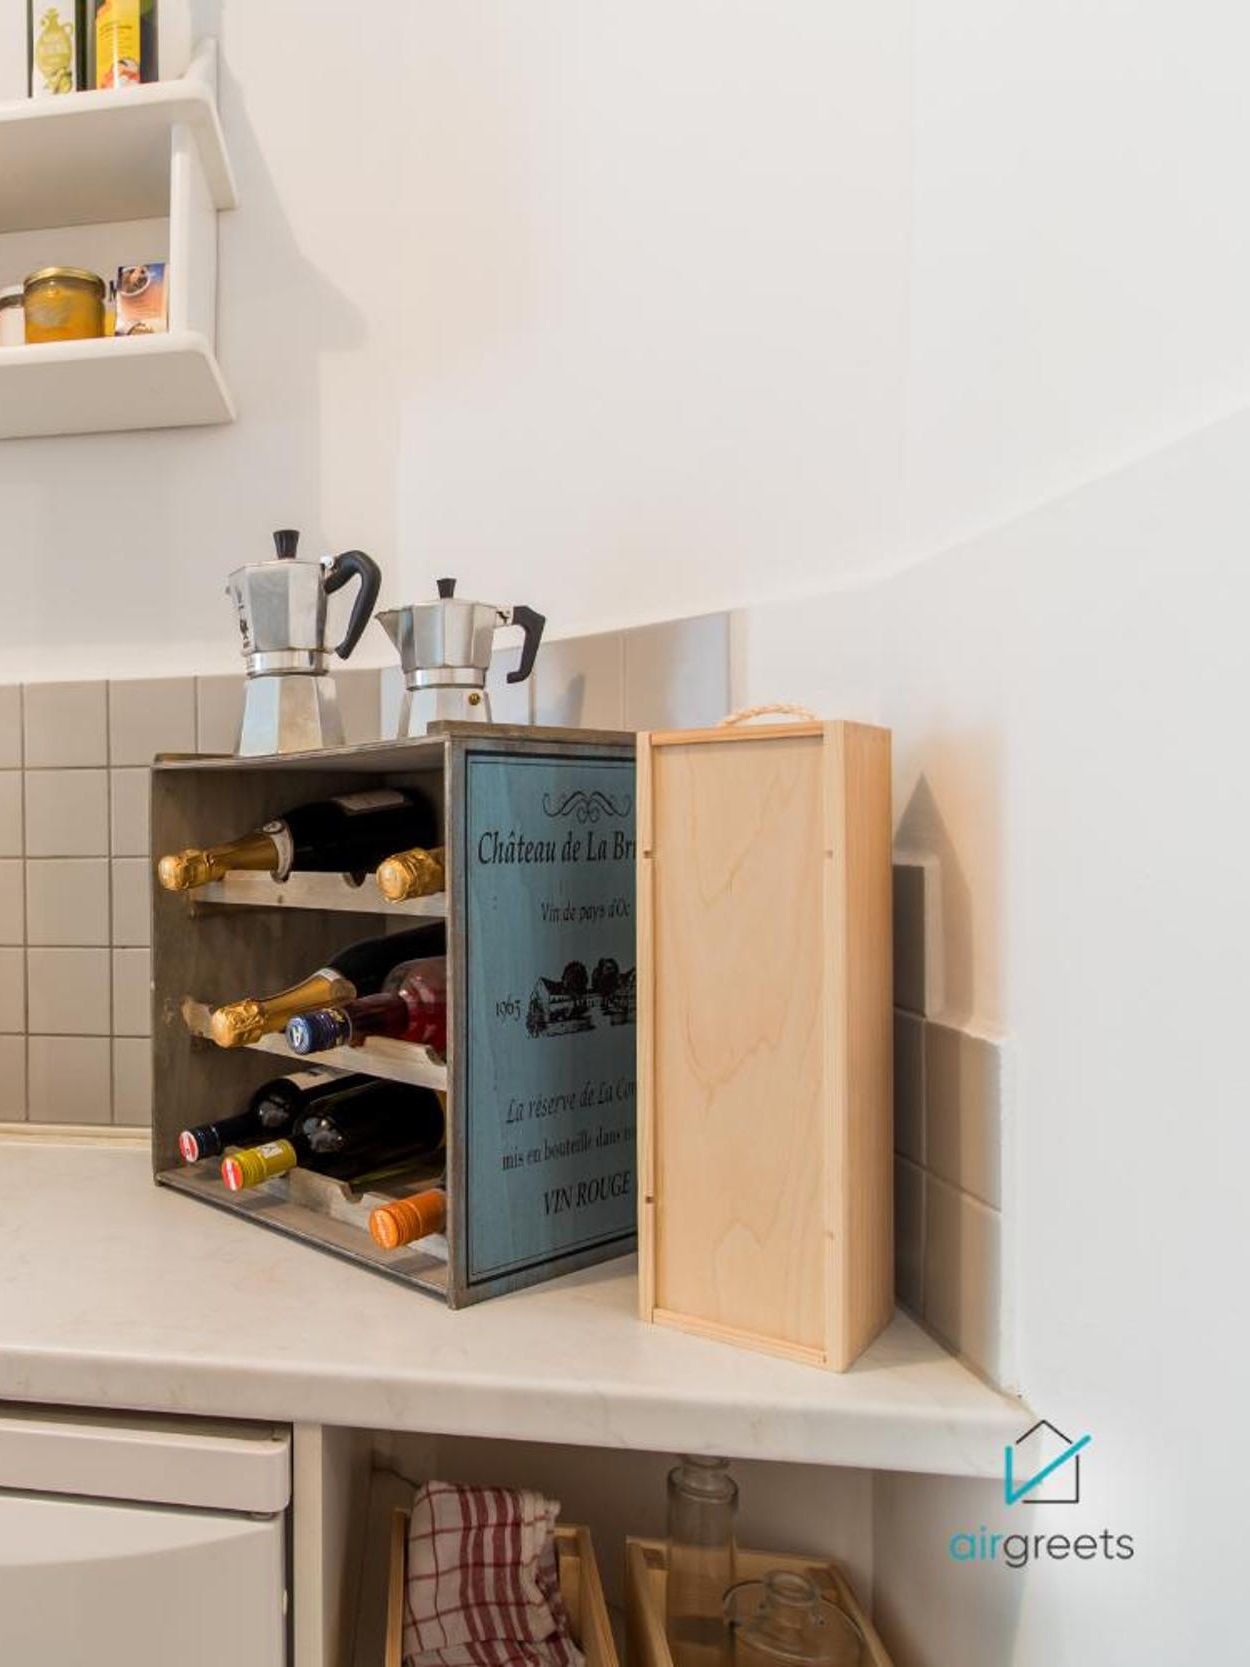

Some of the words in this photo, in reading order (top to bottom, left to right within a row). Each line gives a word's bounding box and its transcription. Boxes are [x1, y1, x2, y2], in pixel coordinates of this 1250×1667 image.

[478, 830, 556, 864] Château
[561, 830, 581, 863] de
[586, 831, 607, 861] La
[541, 901, 559, 922] Vin
[563, 899, 576, 921] de
[579, 903, 605, 923] pays
[506, 1099, 524, 1123] La
[530, 1092, 576, 1119] réserve
[579, 1080, 594, 1107] de
[597, 1081, 612, 1105] La
[502, 1146, 524, 1170] mis
[527, 1148, 542, 1165] en
[544, 1130, 591, 1160] bouteille
[596, 1127, 621, 1147] dans
[544, 1185, 572, 1215] VIN
[576, 1171, 631, 1208] ROUGE
